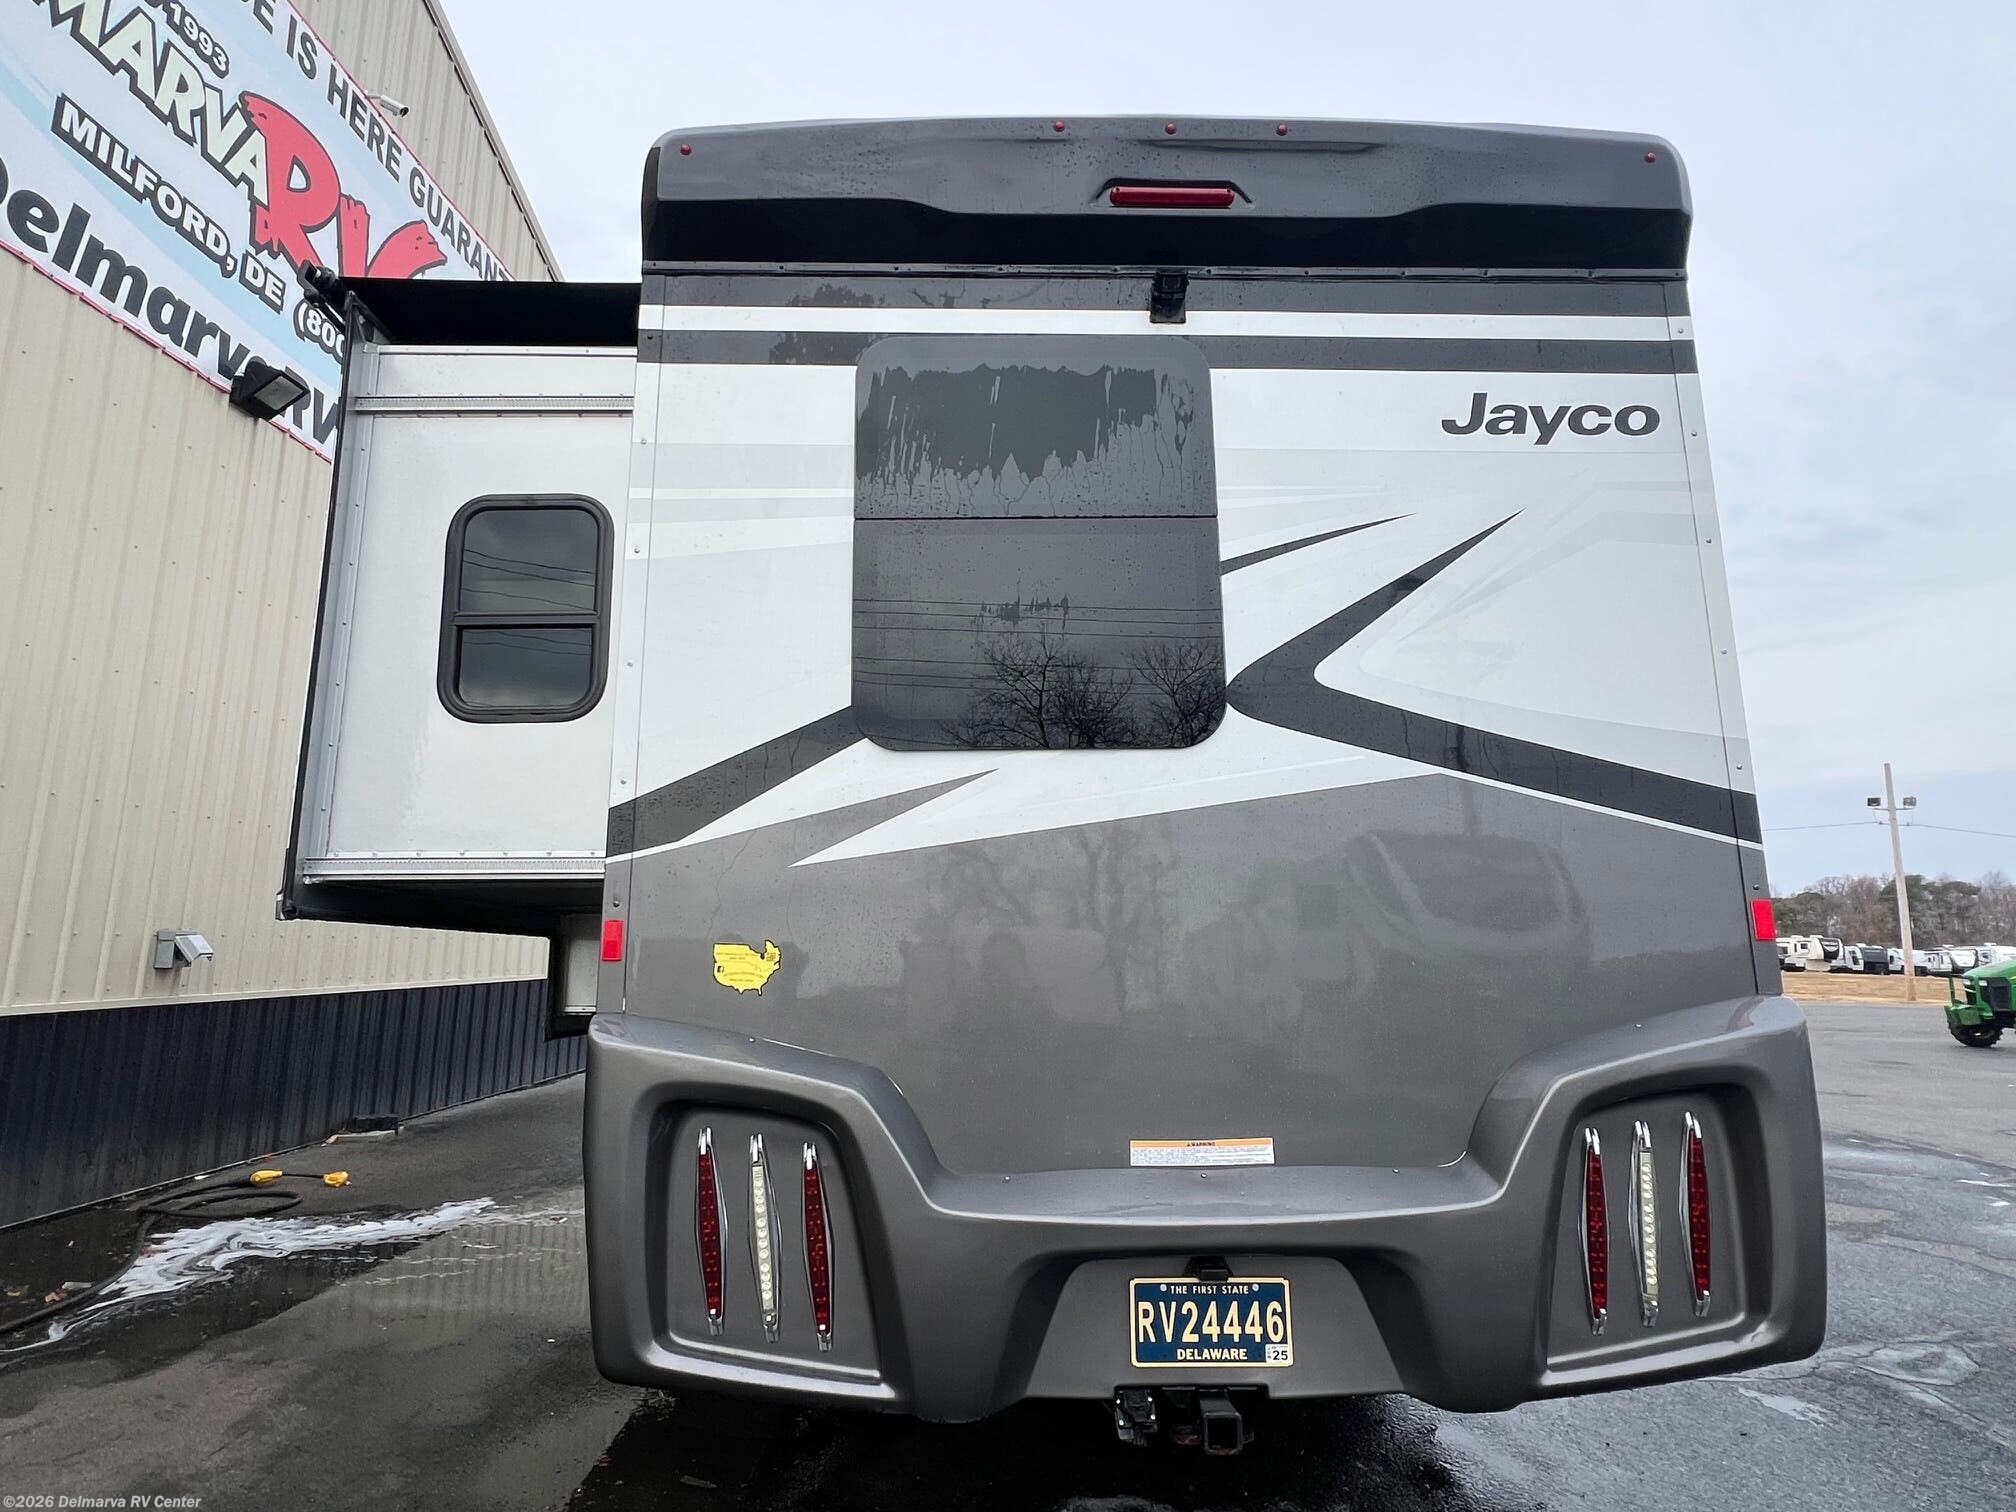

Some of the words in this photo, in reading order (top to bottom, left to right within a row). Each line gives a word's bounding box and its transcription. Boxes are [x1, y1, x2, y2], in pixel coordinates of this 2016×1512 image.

[168, 1, 227, 73] 1993
[286, 14, 318, 80] IS
[327, 64, 403, 183] HERE
[59, 99, 235, 272] MILFORD,
[243, 253, 285, 310] DE
[1441, 392, 1661, 446] Jayco
[1170, 1285, 1187, 1294] THE
[1192, 1285, 1217, 1294] FIRST
[1222, 1285, 1249, 1294] STATE
[1137, 1300, 1285, 1343] RV24446
[1176, 1348, 1248, 1360] DELAWARE
[1272, 1350, 1289, 1361] 25
